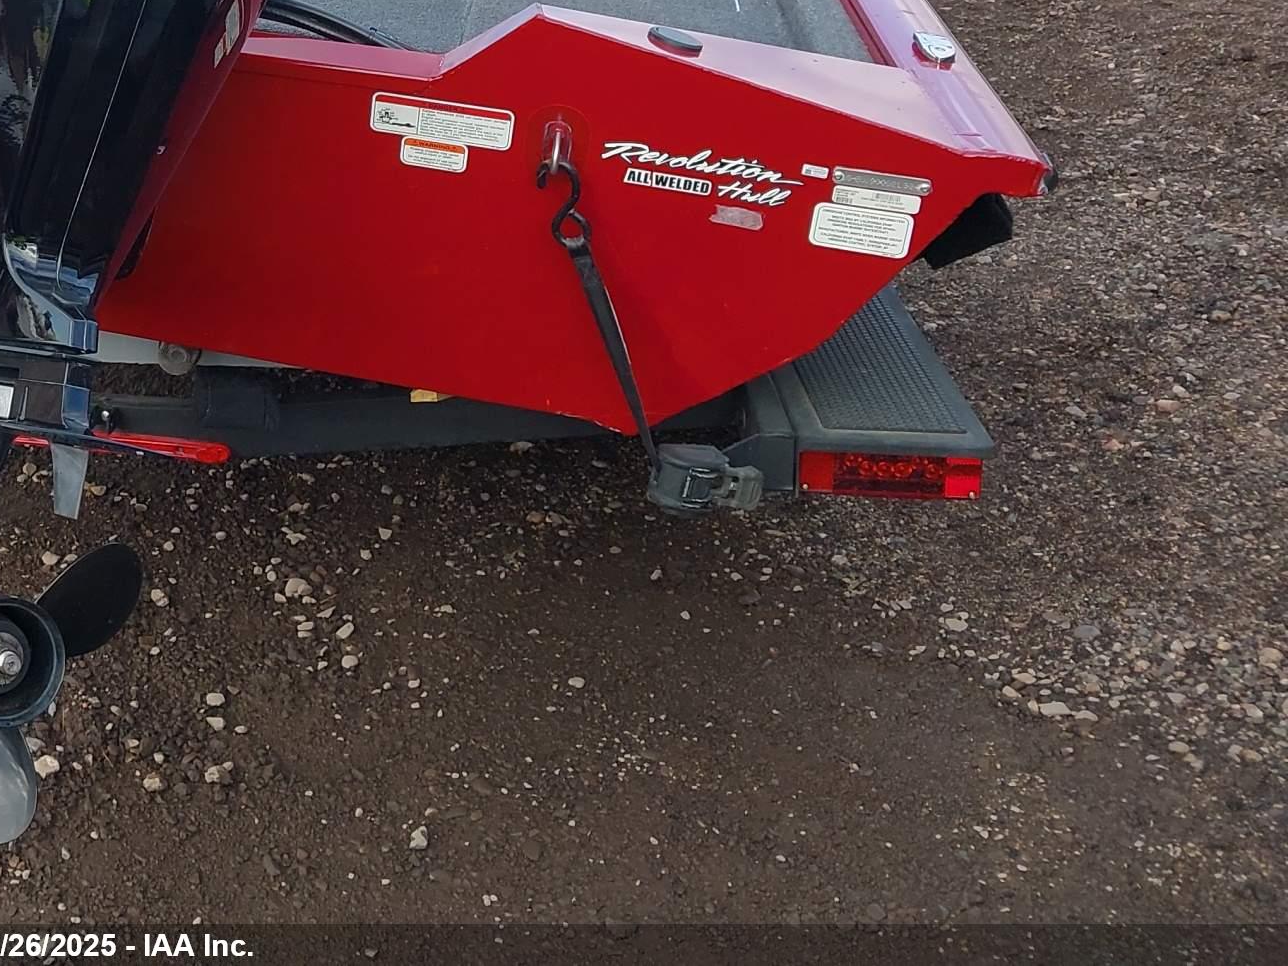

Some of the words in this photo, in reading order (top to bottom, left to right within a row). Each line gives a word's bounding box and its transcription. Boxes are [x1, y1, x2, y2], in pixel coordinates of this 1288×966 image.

[601, 142, 805, 186] Revolution
[626, 170, 652, 184] ALL
[655, 172, 710, 194] WELDED
[717, 181, 792, 207] Hull
